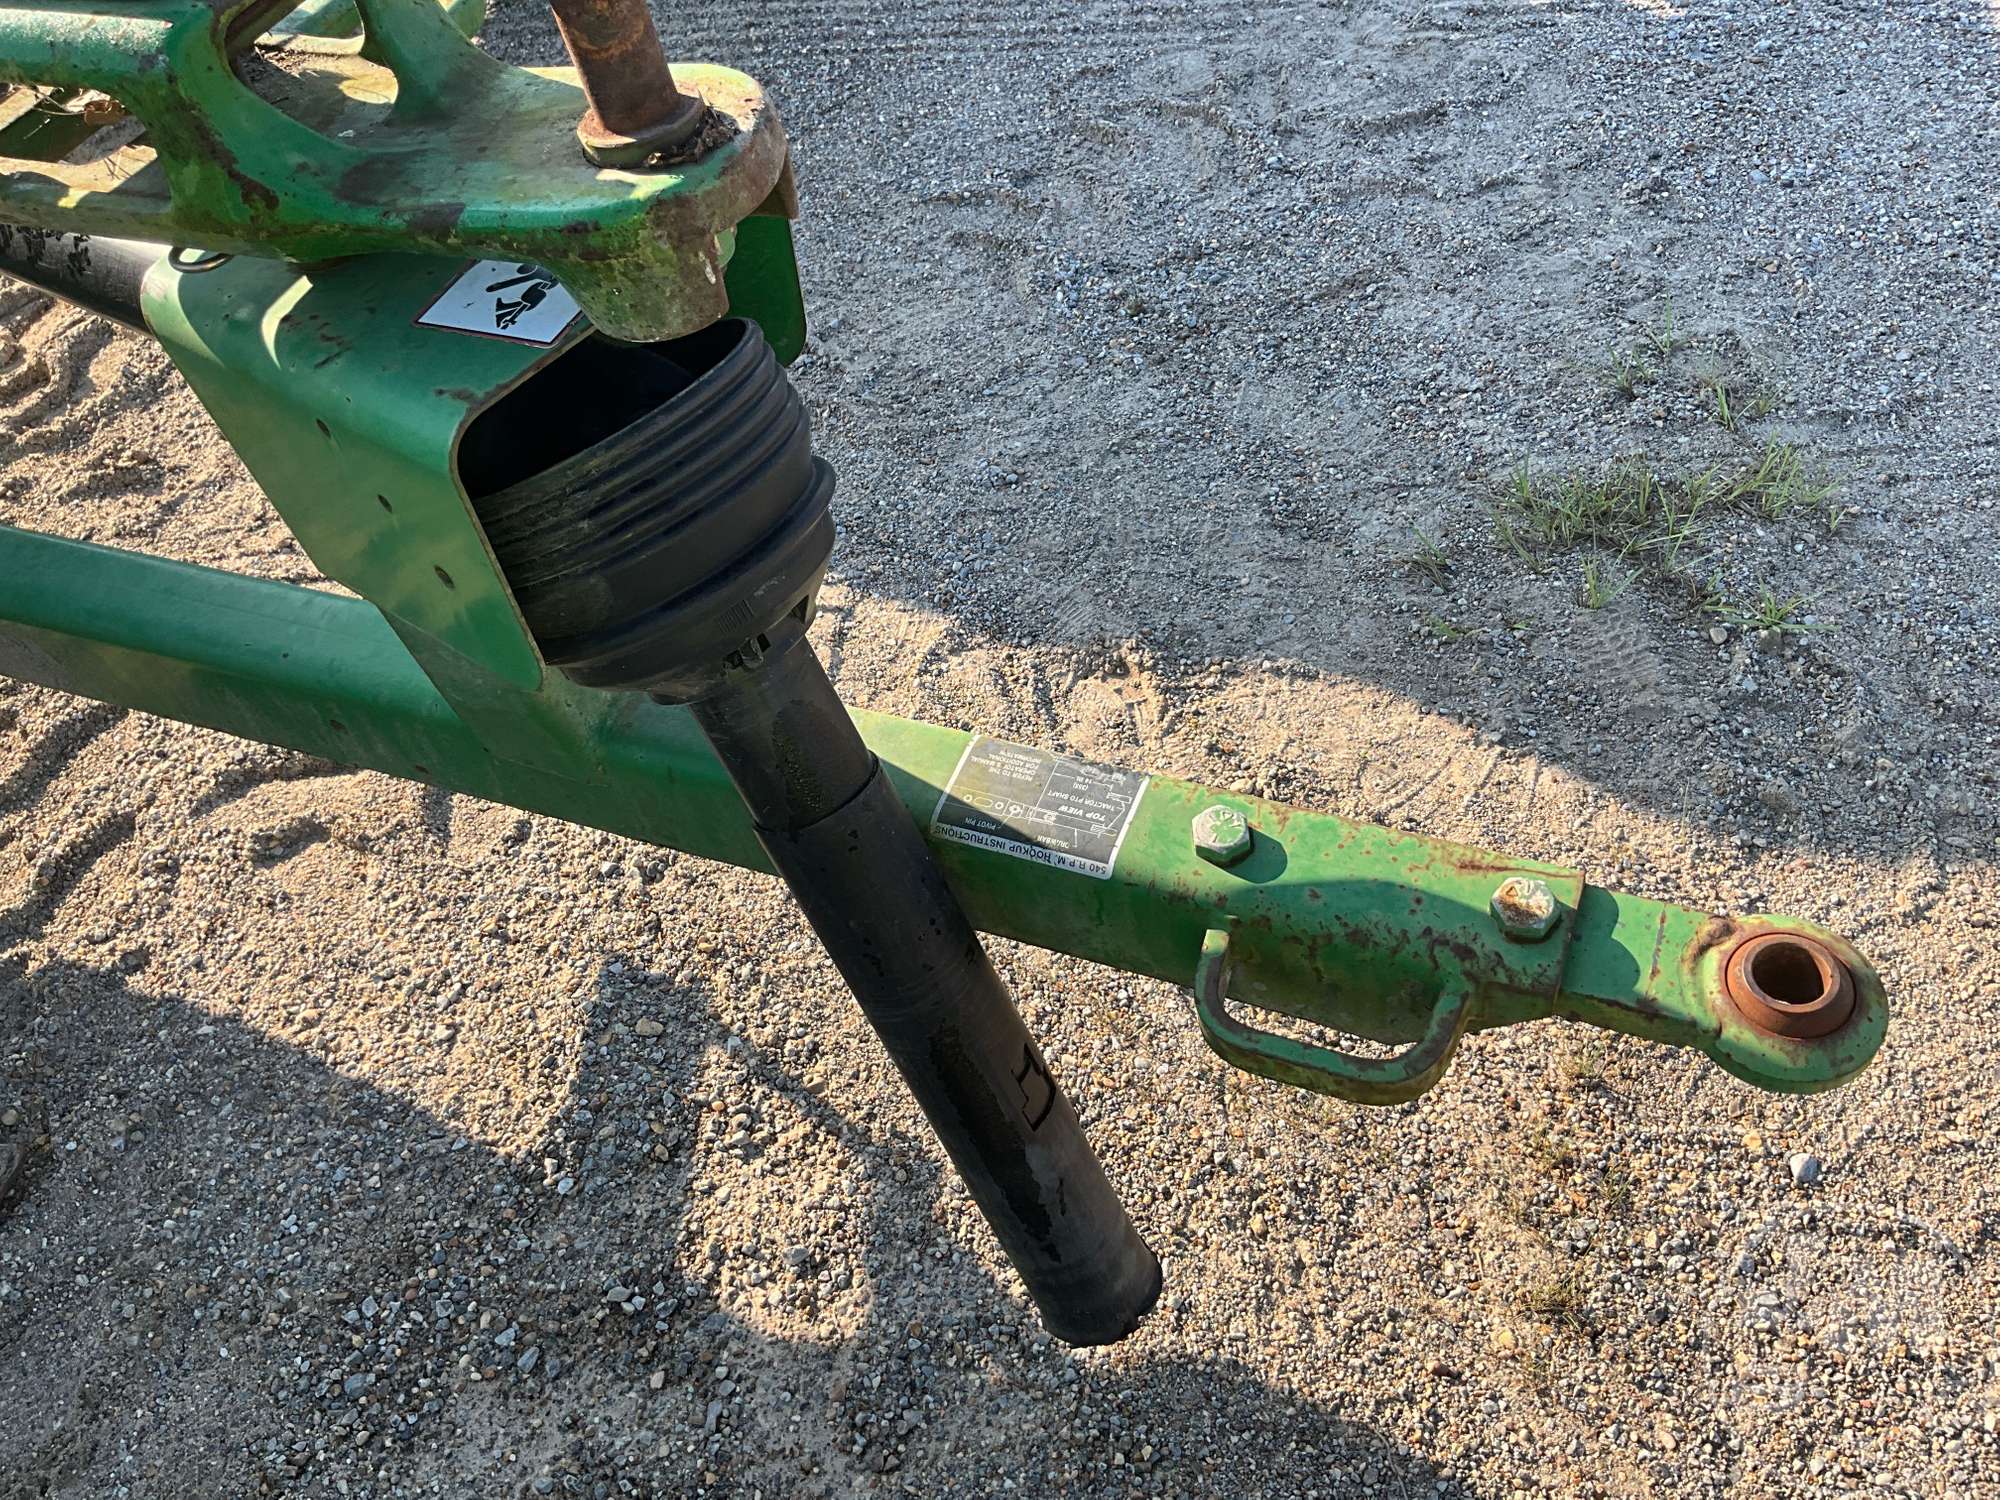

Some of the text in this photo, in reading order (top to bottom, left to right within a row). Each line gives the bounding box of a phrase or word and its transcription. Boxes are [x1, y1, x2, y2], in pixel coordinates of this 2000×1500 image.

[1047, 789, 1115, 812] TRACTOR PTO SHAFT
[1058, 805, 1106, 822] TOP VIEW
[936, 825, 1006, 849] INSTRUCTIONS
[1009, 845, 1051, 862] HOOKUP
[1089, 863, 1108, 875] 540
